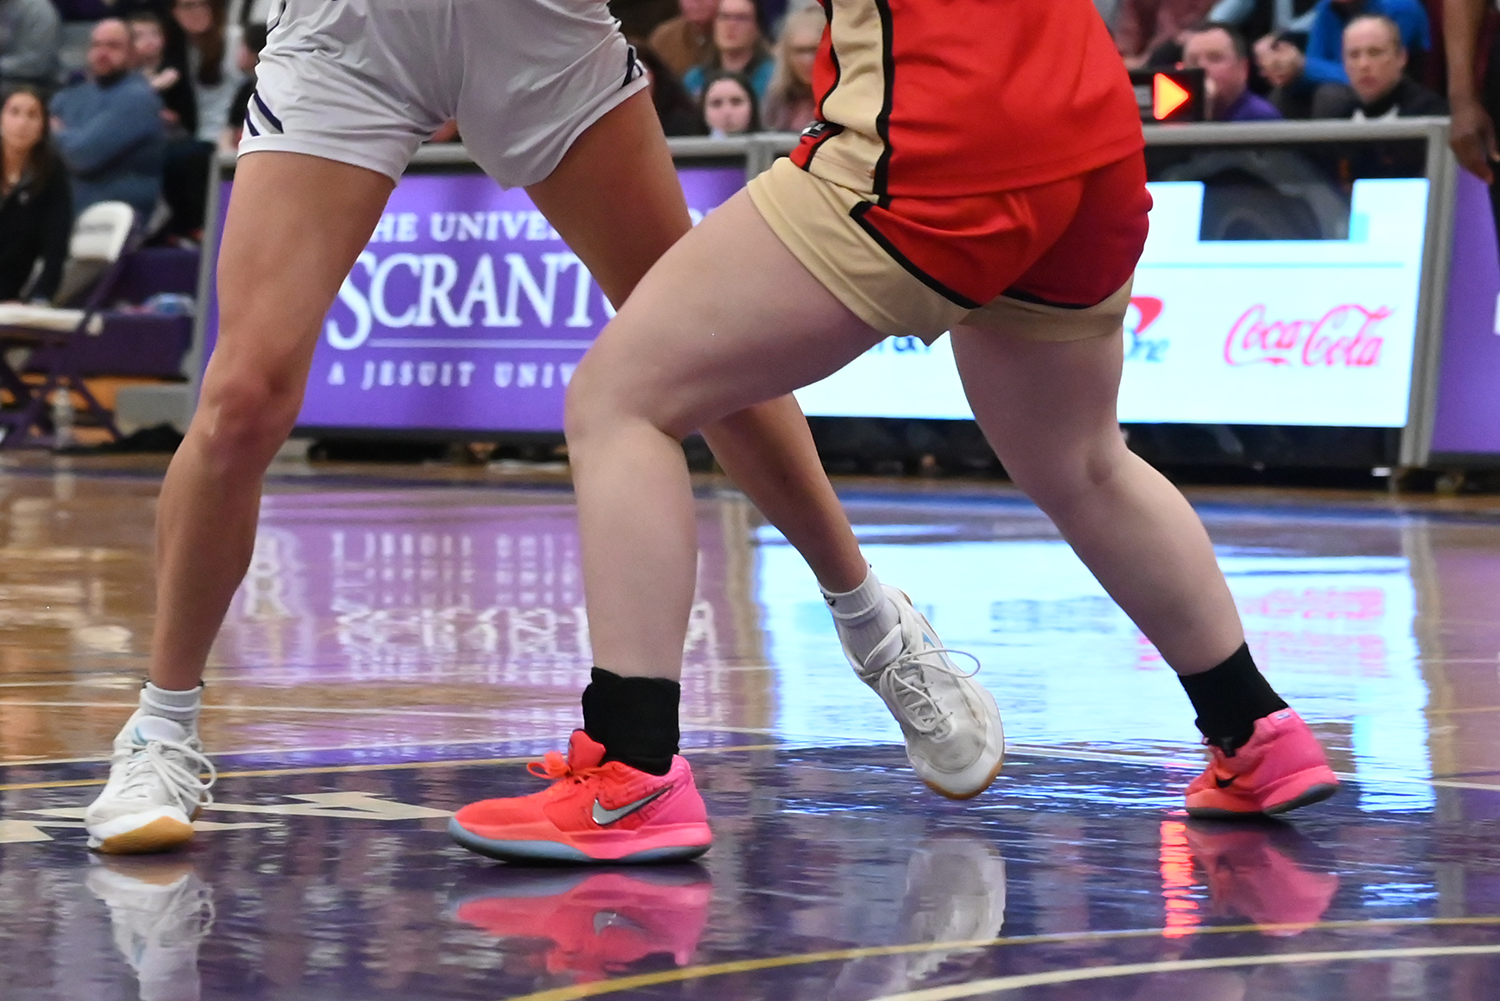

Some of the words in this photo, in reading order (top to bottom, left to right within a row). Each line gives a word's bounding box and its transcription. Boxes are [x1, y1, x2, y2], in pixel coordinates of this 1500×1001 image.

[369, 211, 418, 243] HE
[429, 210, 562, 242] UNIVE
[326, 251, 617, 350] SCRANT
[328, 361, 346, 386] A
[361, 360, 476, 390] JESUIT
